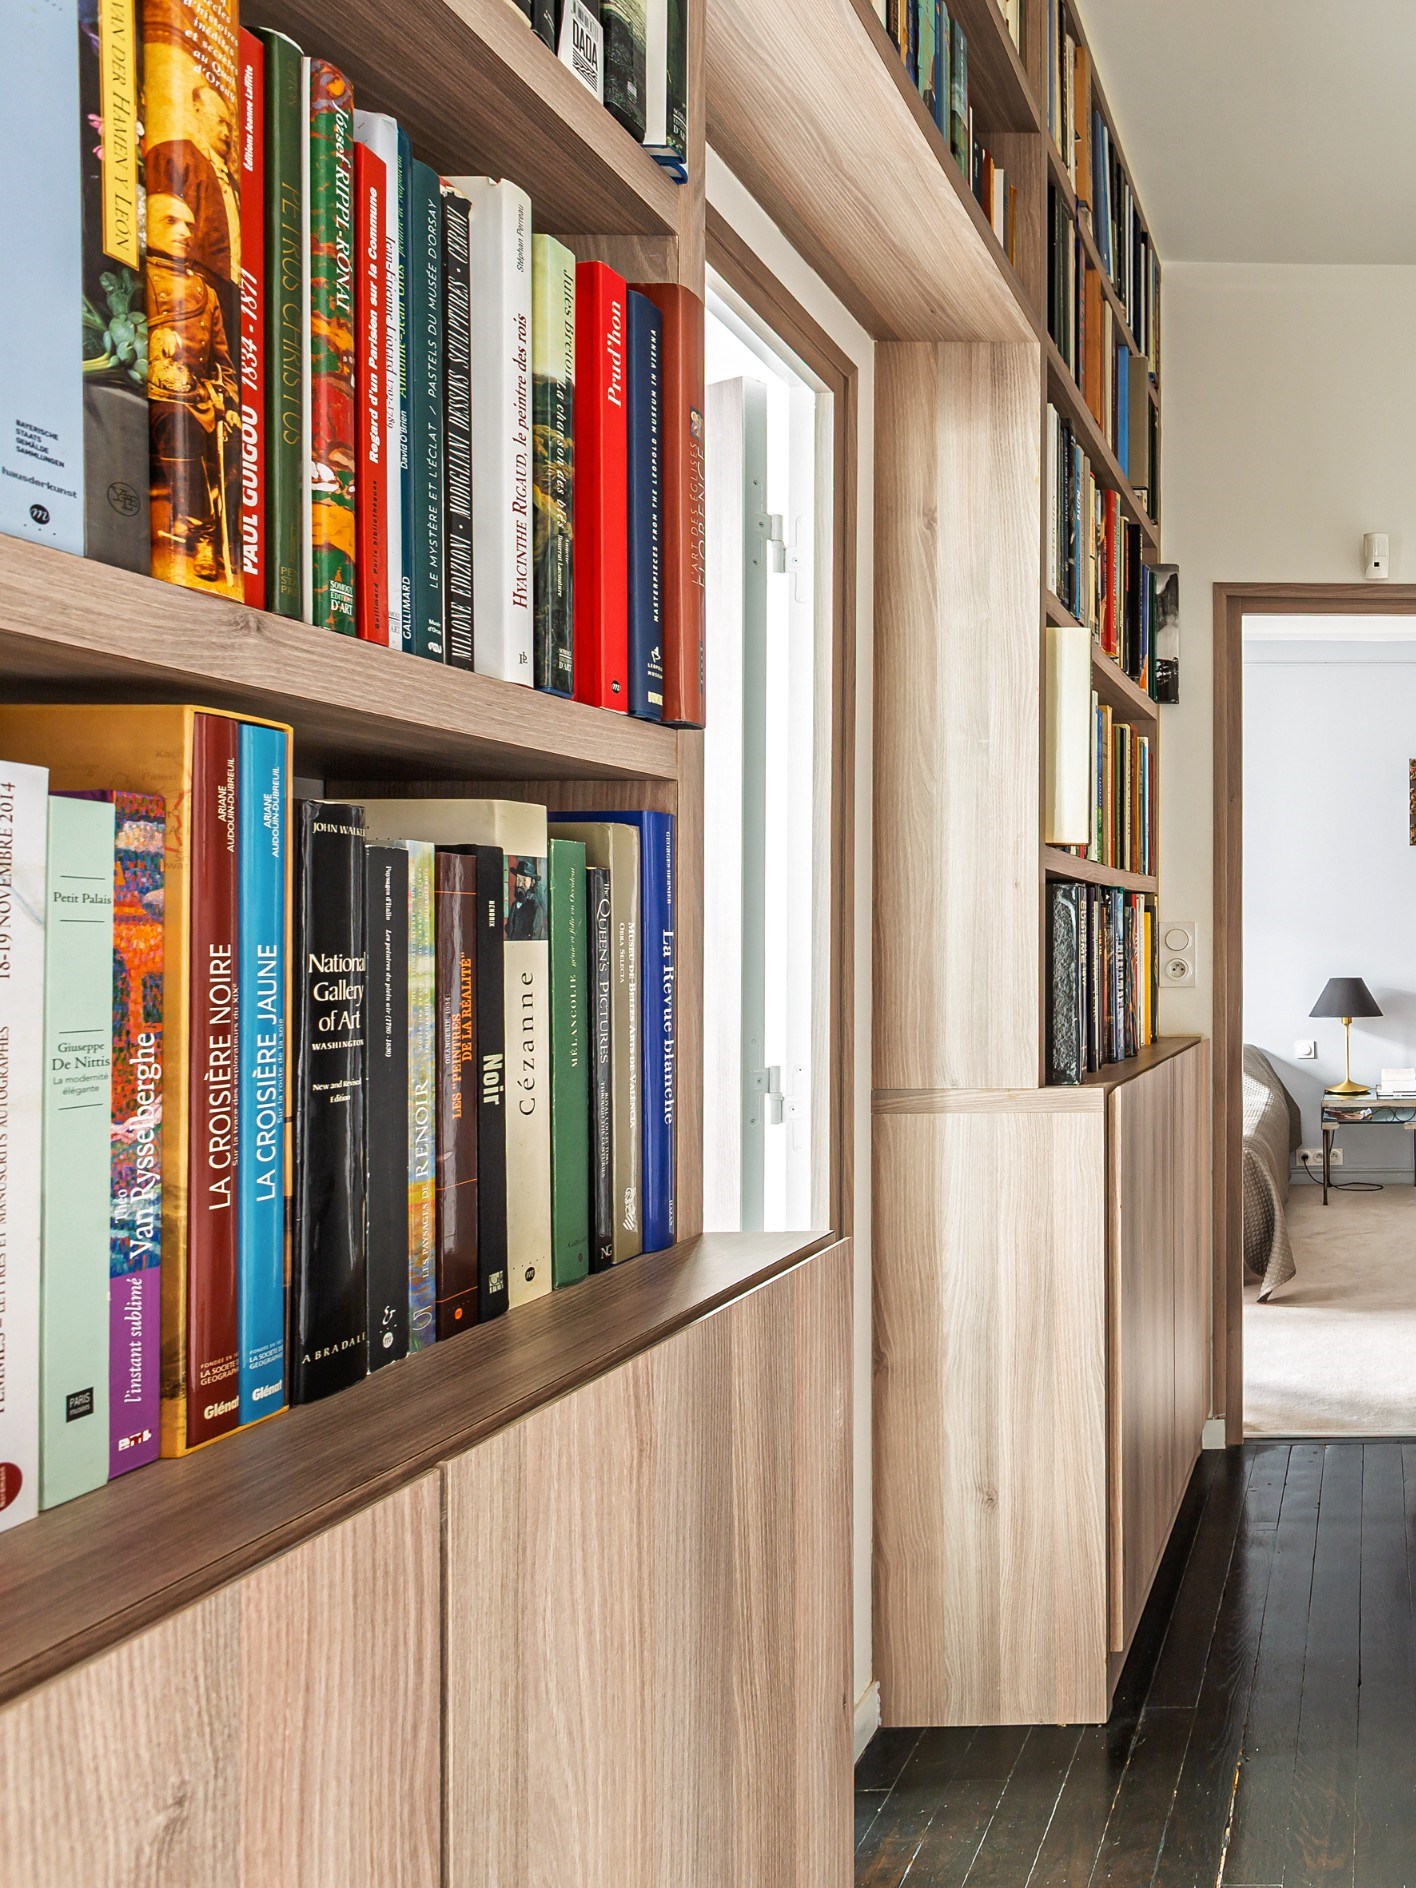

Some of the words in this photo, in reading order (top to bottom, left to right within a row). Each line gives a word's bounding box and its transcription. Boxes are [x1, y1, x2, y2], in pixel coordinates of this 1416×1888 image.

[110, 0, 126, 41] VAN
[193, 17, 235, 56] inédites
[184, 29, 199, 42] et
[202, 40, 238, 76] secrètes
[572, 17, 599, 72] DADA
[111, 44, 127, 87] DER
[193, 50, 208, 64] au
[212, 61, 236, 88] Quai
[193, 64, 235, 104] d'Orsay
[243, 64, 253, 100] Laffitte
[112, 91, 131, 171] HAMEN
[244, 100, 253, 134] Jeanne
[332, 102, 352, 167] József
[243, 133, 253, 171] Éditions
[114, 174, 129, 189] Y
[115, 192, 133, 251] LEÓN
[334, 165, 353, 313] RIPPL-RÓNAI
[367, 186, 378, 260] Commune
[428, 198, 438, 260] D'ORSAY
[447, 204, 469, 264] CERONI
[516, 204, 525, 238] Perreau
[368, 264, 378, 279] la
[516, 239, 526, 273] Stéphan
[240, 267, 259, 322] 1871
[369, 282, 378, 307] sur
[426, 263, 437, 310] MUSÉE
[563, 268, 575, 317] Jules
[368, 310, 379, 370] Parisien
[428, 314, 437, 336] DU
[447, 276, 469, 369] SCULPTURES
[512, 313, 527, 344] rois
[241, 337, 258, 391] 1834
[428, 340, 438, 398] PASTELS
[512, 346, 527, 373] des
[564, 319, 575, 382] Breton
[607, 300, 622, 408] Prud'hon
[281, 303, 302, 446] CHRISTUS
[368, 373, 379, 406] d'un
[556, 379, 567, 400] La
[650, 373, 657, 386] IN
[447, 369, 470, 432] DESSINS
[513, 375, 530, 431] peintre
[15, 419, 59, 441] BAYERISCHE
[15, 428, 42, 443] STAATS
[15, 437, 49, 454] GEMÄLDE
[369, 408, 380, 464] Regard
[511, 432, 527, 447] le
[556, 404, 567, 464] chanson
[15, 445, 65, 468] SAMMLUNGEN
[241, 403, 259, 504] GUIGOU
[426, 423, 438, 478] L'ÉCLAT
[1, 466, 78, 498] hausderkunst
[428, 482, 438, 500] ET
[449, 431, 471, 520] MODIGLIANI
[512, 452, 528, 517] RIGAUD,
[556, 470, 567, 494] des
[689, 441, 698, 502] ÉGLISES
[427, 505, 438, 568] MYSTÈRE
[690, 509, 698, 536] DES
[242, 512, 259, 576] PAUL
[691, 542, 699, 585] L'ART
[429, 573, 439, 589] LE
[450, 533, 471, 598] EDIZIONI
[512, 520, 528, 610] HYACINTHE
[331, 599, 353, 616] D'ART
[402, 576, 412, 639] GALLIMARD
[451, 602, 472, 661] MILIONE
[217, 785, 227, 822] ARIANE
[226, 757, 235, 853] AUDOUIN-DUBREUIL
[263, 793, 272, 829] ARIANE
[271, 766, 280, 858] AUDOUIN-DUBREUIL
[312, 822, 338, 834] JOHN
[339, 825, 366, 837] WALKE
[53, 891, 79, 903] Petit
[81, 892, 112, 905] Palais
[596, 898, 611, 972] QUEEN'S
[662, 929, 675, 957] La
[308, 951, 366, 974] National
[208, 943, 232, 1025] NOIRE
[256, 944, 278, 1025] JAUNE
[313, 979, 364, 1007] Gallery
[662, 964, 675, 1033] Revue
[232, 1007, 239, 1020] du
[276, 1018, 284, 1039] soie
[318, 1009, 338, 1032] of
[337, 1010, 361, 1031] Art
[462, 1020, 472, 1039] LA
[598, 981, 609, 1064] PICTURES
[52, 1058, 71, 1071] De
[75, 1055, 111, 1069] Nittis
[57, 1042, 105, 1054] Giuseppe
[232, 1023, 240, 1085] explorateurs
[276, 1052, 284, 1063] de
[311, 1038, 364, 1051] WASHINGTON
[462, 1041, 472, 1062] DE
[517, 972, 536, 1116] Cézanne
[53, 1077, 63, 1085] La
[65, 1073, 109, 1084] modernité
[62, 1085, 100, 1096] élégante
[251, 1033, 277, 1163] CROISIÈRE
[312, 1083, 329, 1092] New
[330, 1079, 342, 1089] and
[342, 1077, 362, 1087] Revised
[329, 1093, 351, 1104] Edition
[482, 1053, 504, 1106] Noir
[663, 1038, 675, 1125] blanche
[128, 1032, 161, 1203] Rysselberghe
[203, 1034, 232, 1170] CROISIÈRE
[276, 1106, 284, 1124] Sur
[452, 1092, 462, 1120] LES
[415, 1078, 429, 1179] RENOIR
[208, 1176, 231, 1211] LA
[255, 1169, 276, 1202] LA
[421, 1185, 429, 1199] DE
[129, 1209, 154, 1260] Van
[600, 1244, 613, 1260] NG
[123, 1277, 143, 1337] sublimé
[301, 1331, 366, 1365] ABRADALE
[123, 1340, 142, 1403] l'instant
[252, 1379, 283, 1402] Glénat
[69, 1391, 91, 1407] PARIS
[203, 1394, 240, 1420] Glénat
